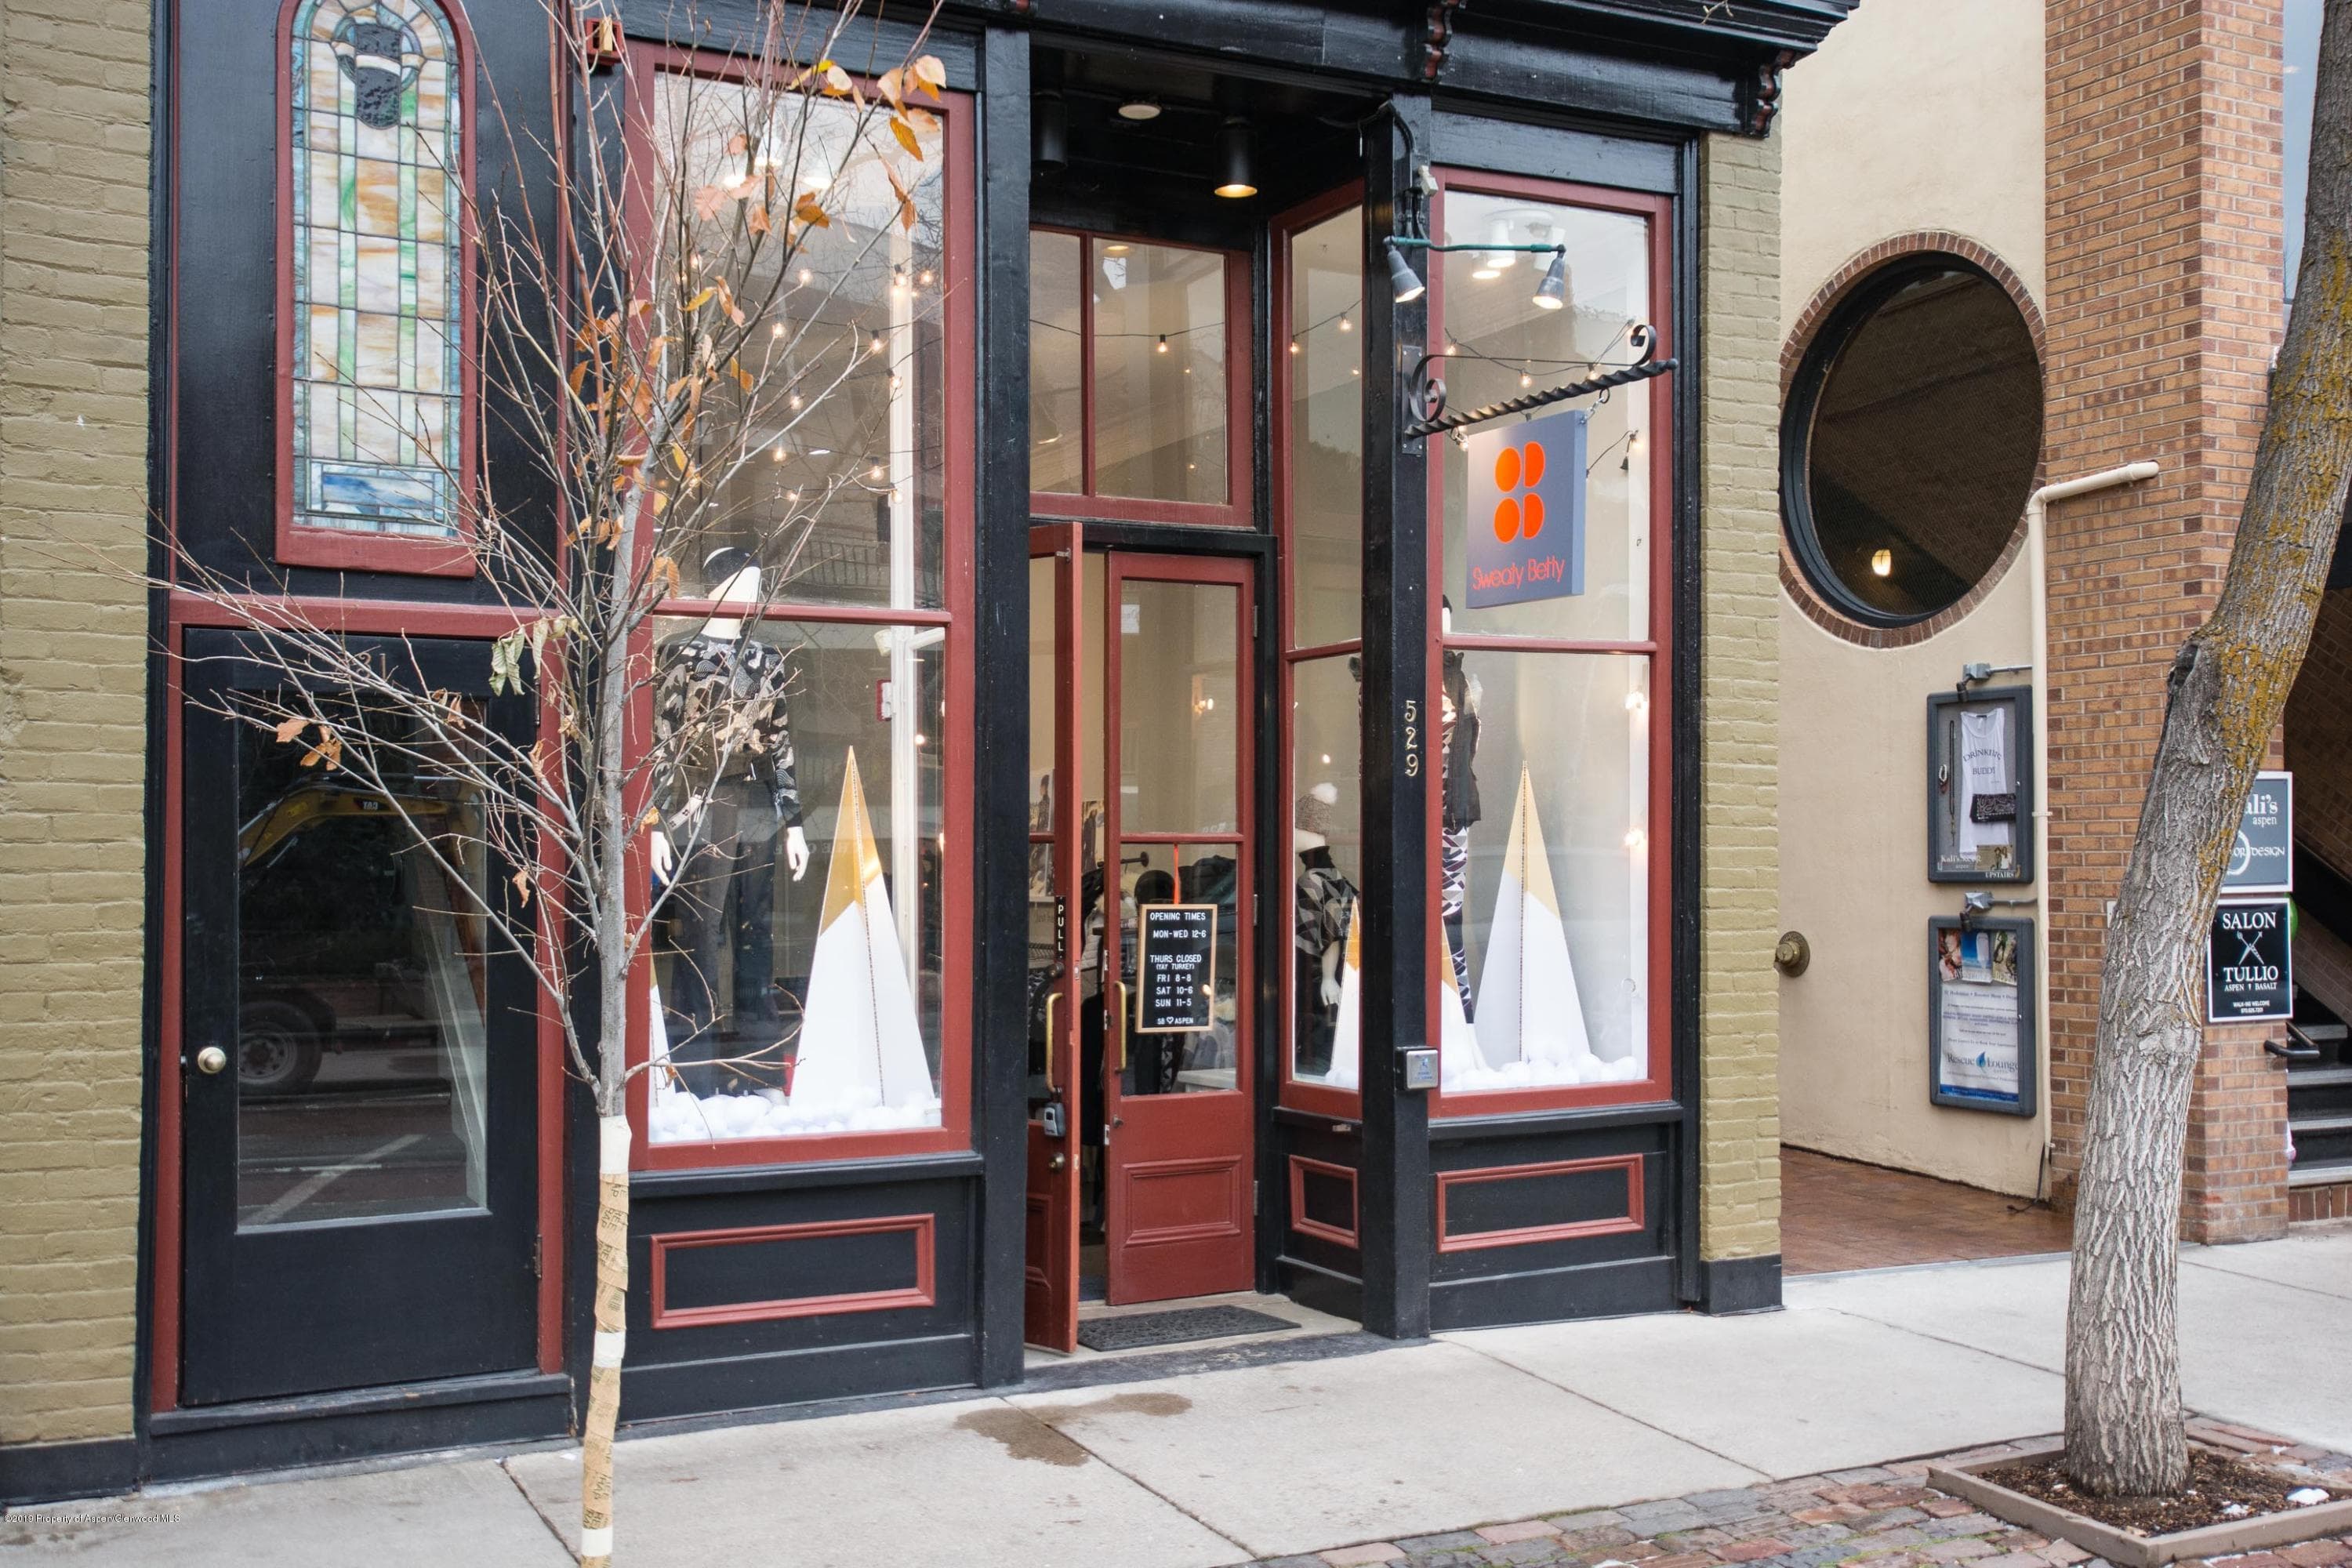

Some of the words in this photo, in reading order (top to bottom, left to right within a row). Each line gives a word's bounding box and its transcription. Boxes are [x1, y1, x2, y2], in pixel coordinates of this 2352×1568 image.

[1472, 562, 1523, 590] Sweaty
[1527, 555, 1565, 585] Betty
[1405, 699, 1419, 777] 529
[2245, 793, 2278, 815] ali's
[2252, 816, 2277, 828] aspen
[2251, 847, 2285, 856] DESIGN
[1150, 912, 1181, 920] OPENING
[1185, 912, 1206, 920] TIMES
[2223, 912, 2277, 930] SALON
[1150, 954, 1173, 963] THURS
[1176, 954, 1202, 963] CLOSED
[1157, 974, 1170, 982] FRI
[2223, 965, 2278, 982] TULLIO
[1156, 986, 1171, 995] SAT
[2255, 982, 2278, 991] BASALT
[1947, 1053, 1976, 1065] Rescue
